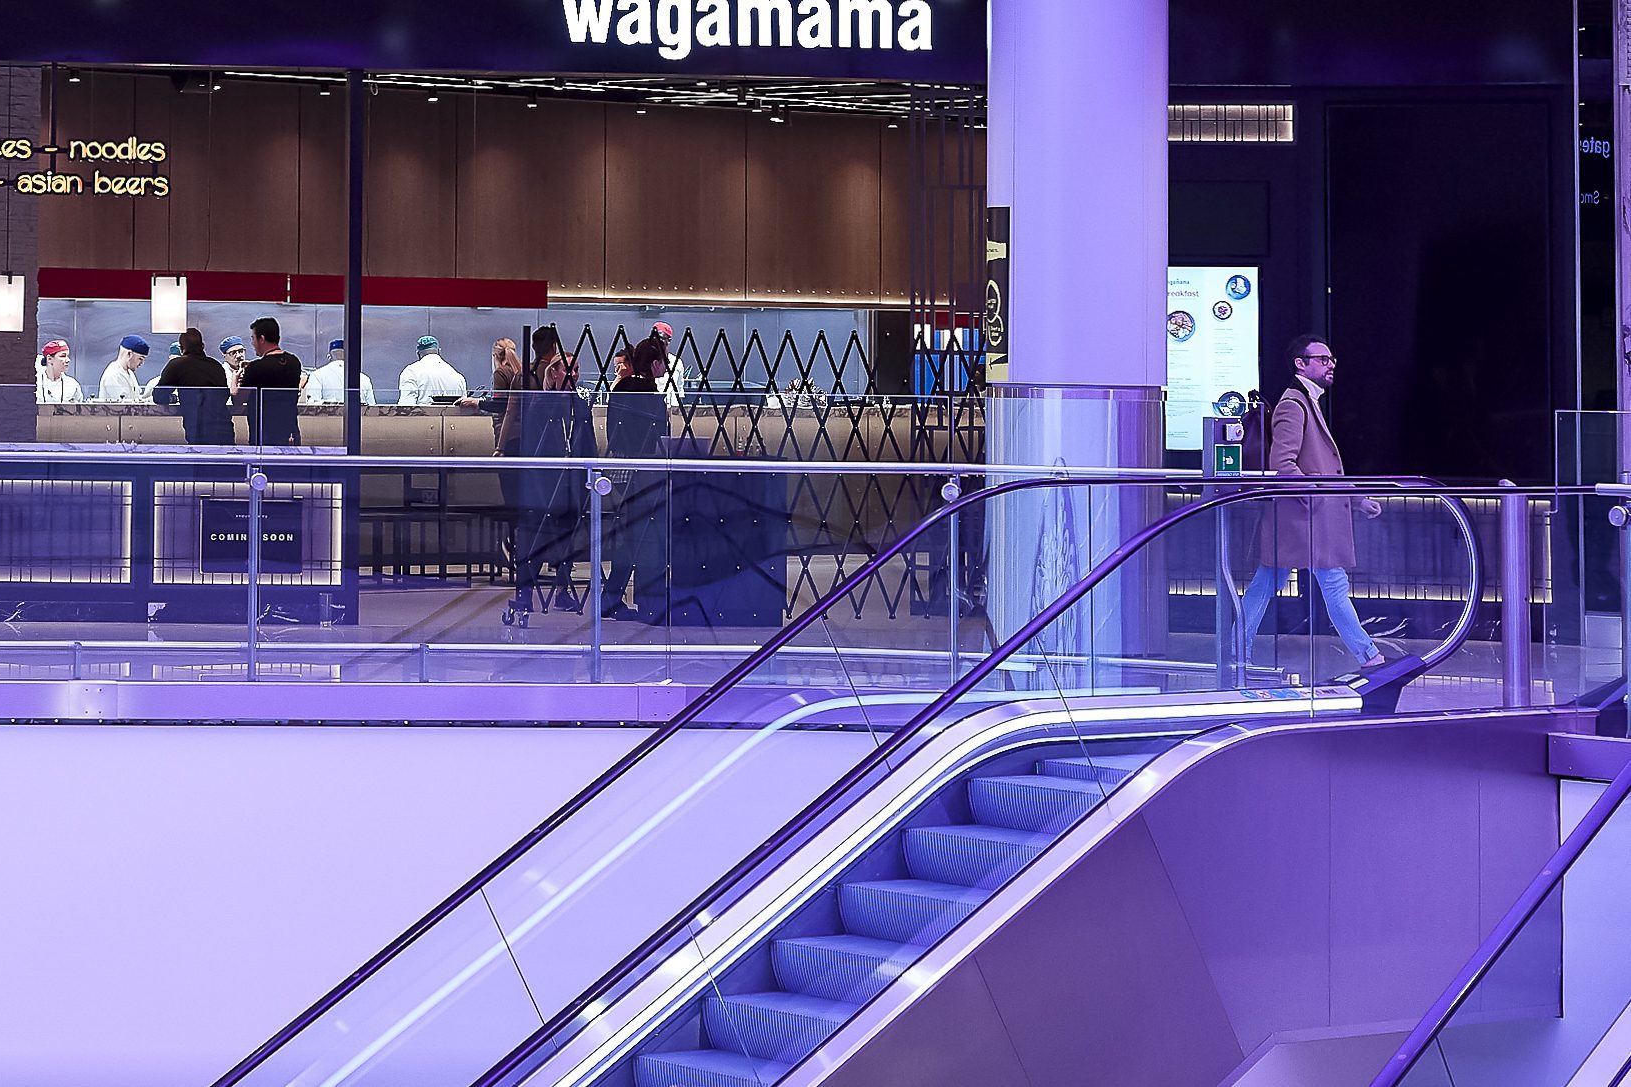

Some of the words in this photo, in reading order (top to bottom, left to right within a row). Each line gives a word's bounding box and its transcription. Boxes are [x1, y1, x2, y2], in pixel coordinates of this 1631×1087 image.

[69, 136, 167, 162] noodles
[17, 170, 83, 194] asian
[94, 169, 169, 197] beers
[210, 533, 248, 542] COMIN
[262, 533, 295, 542] SOON
